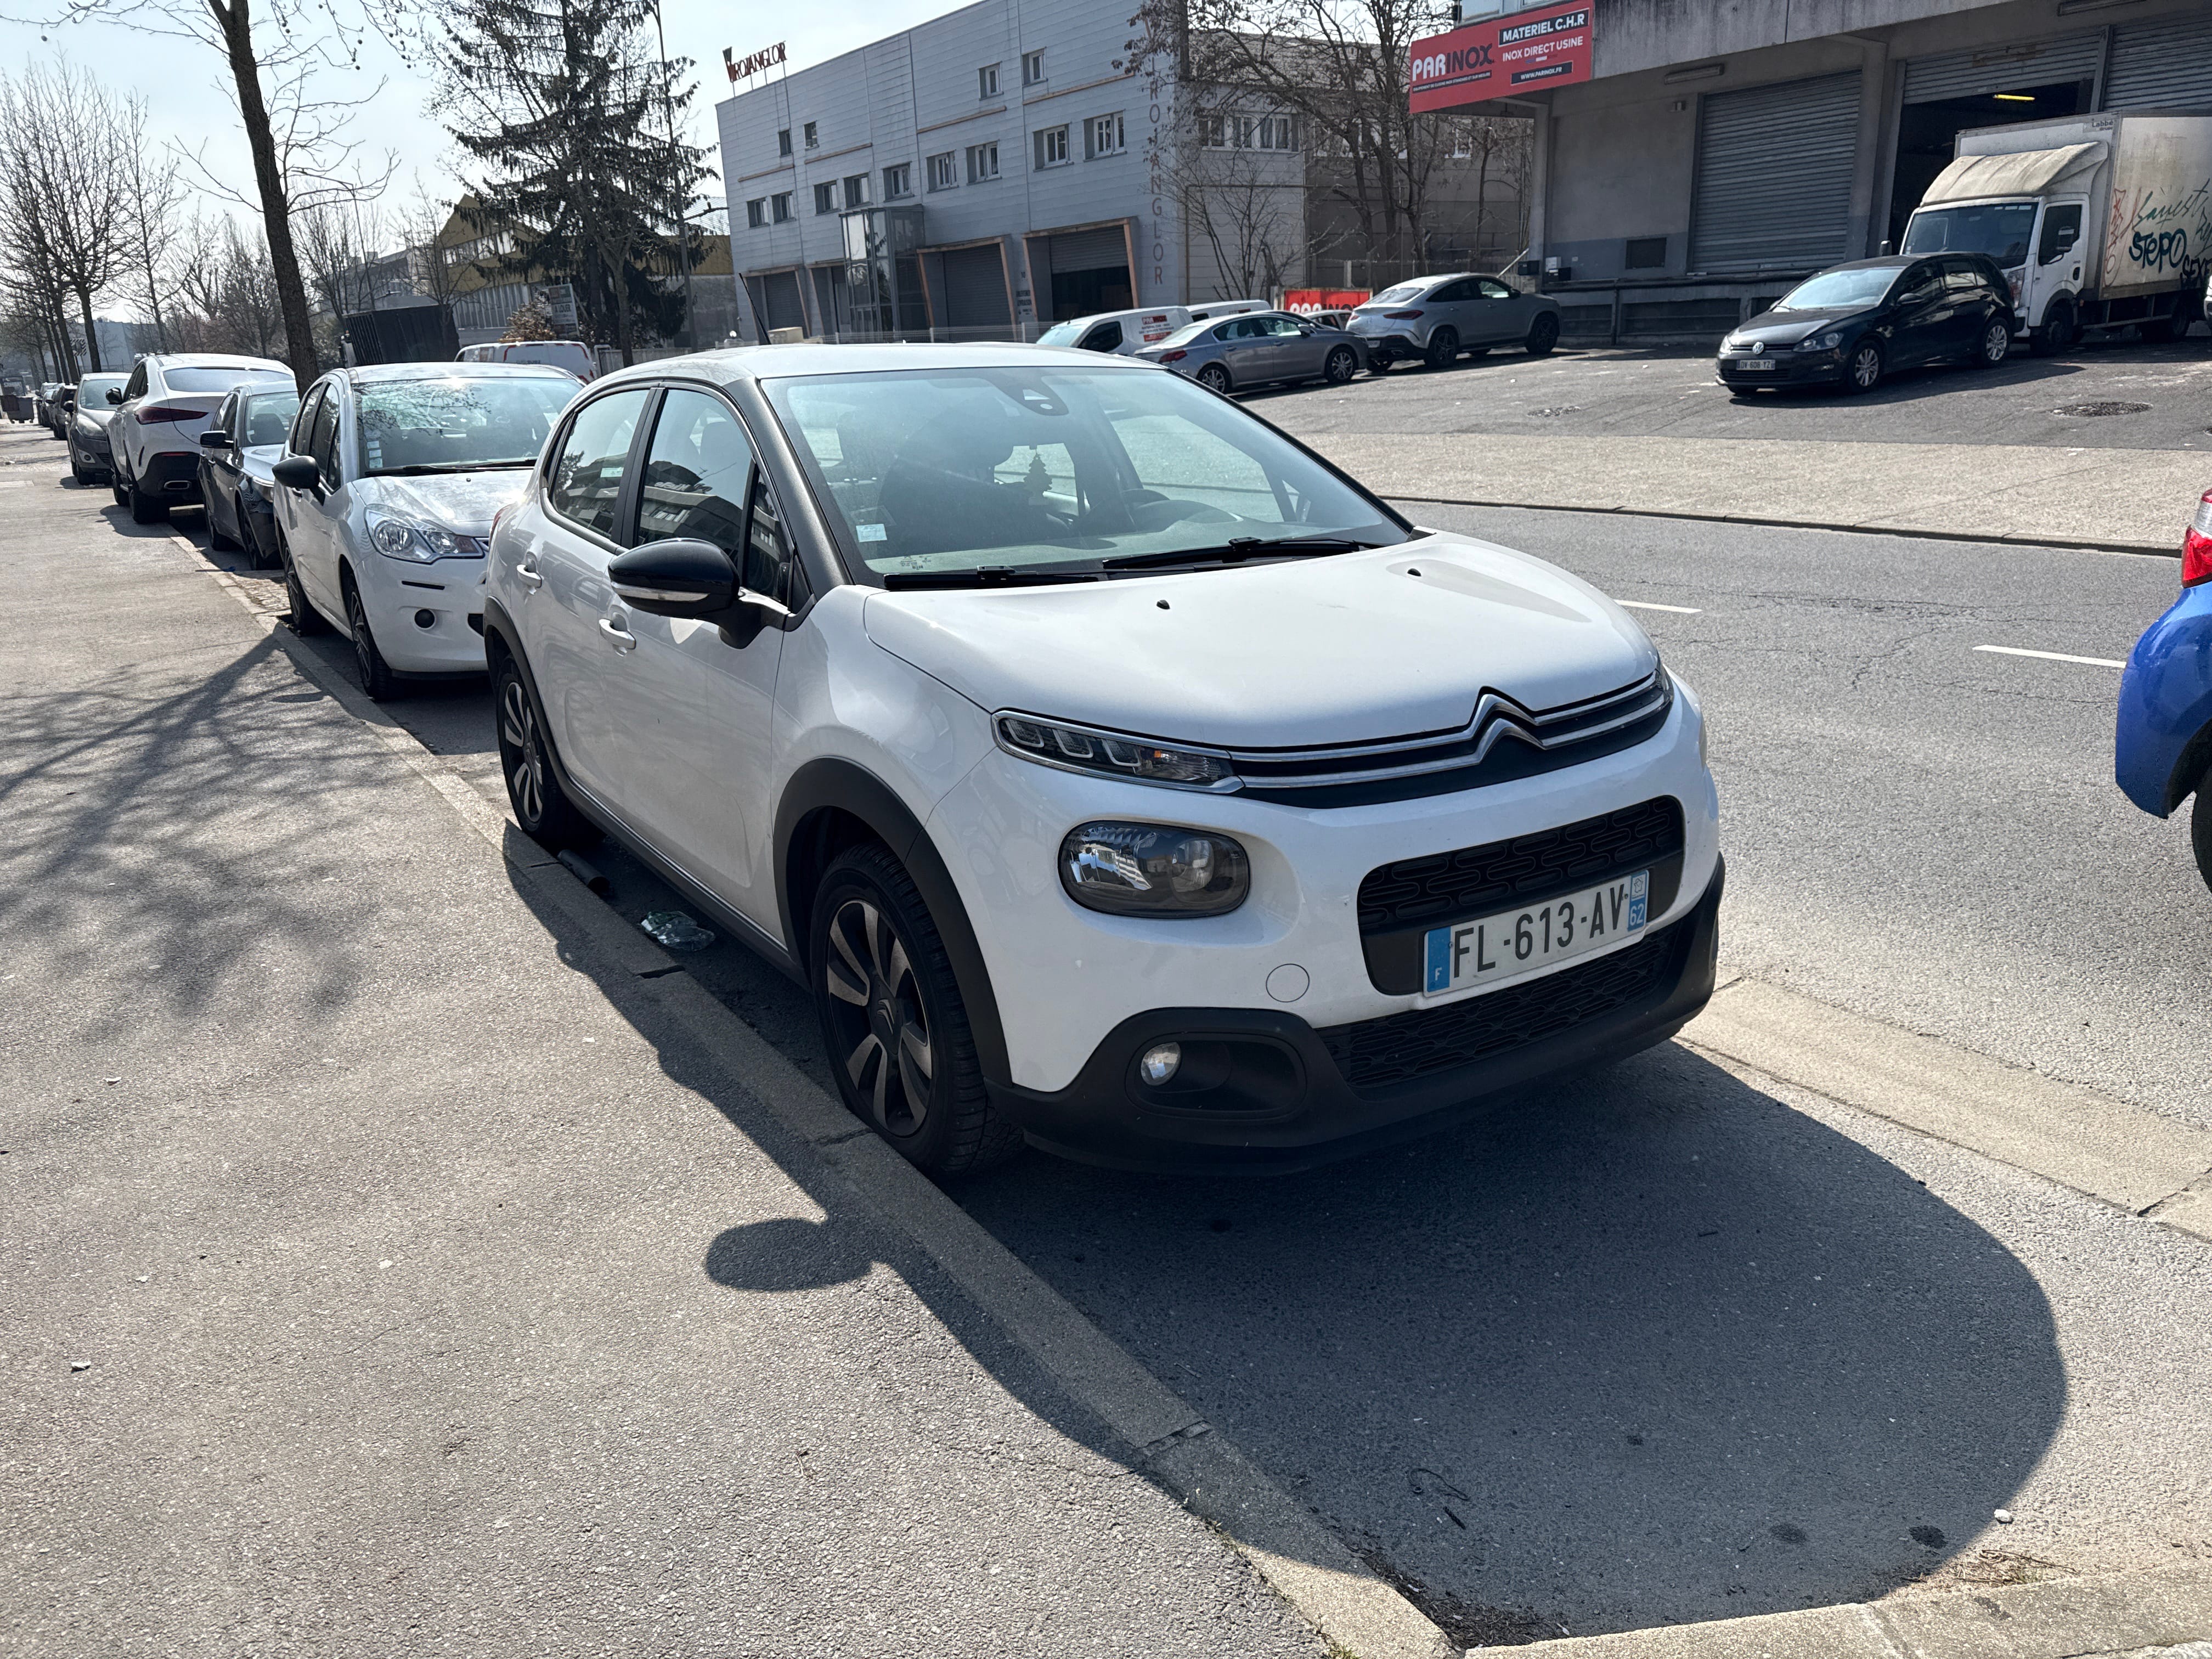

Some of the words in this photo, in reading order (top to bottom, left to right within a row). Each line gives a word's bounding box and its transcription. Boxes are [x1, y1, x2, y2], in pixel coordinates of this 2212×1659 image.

[1503, 21, 1554, 43] MATERIEL
[1555, 13, 1585, 30] C.H.R
[1503, 49, 1522, 61] INOX
[1524, 42, 1555, 57] DIRECT
[1556, 36, 1583, 50] USINE
[1412, 43, 1492, 81] PARINOX
[1520, 66, 1562, 80] WWW.PARINOX.FR
[1630, 903, 1645, 926] 62
[1454, 884, 1624, 978] FL-613-AV
[1435, 967, 1442, 981] F
